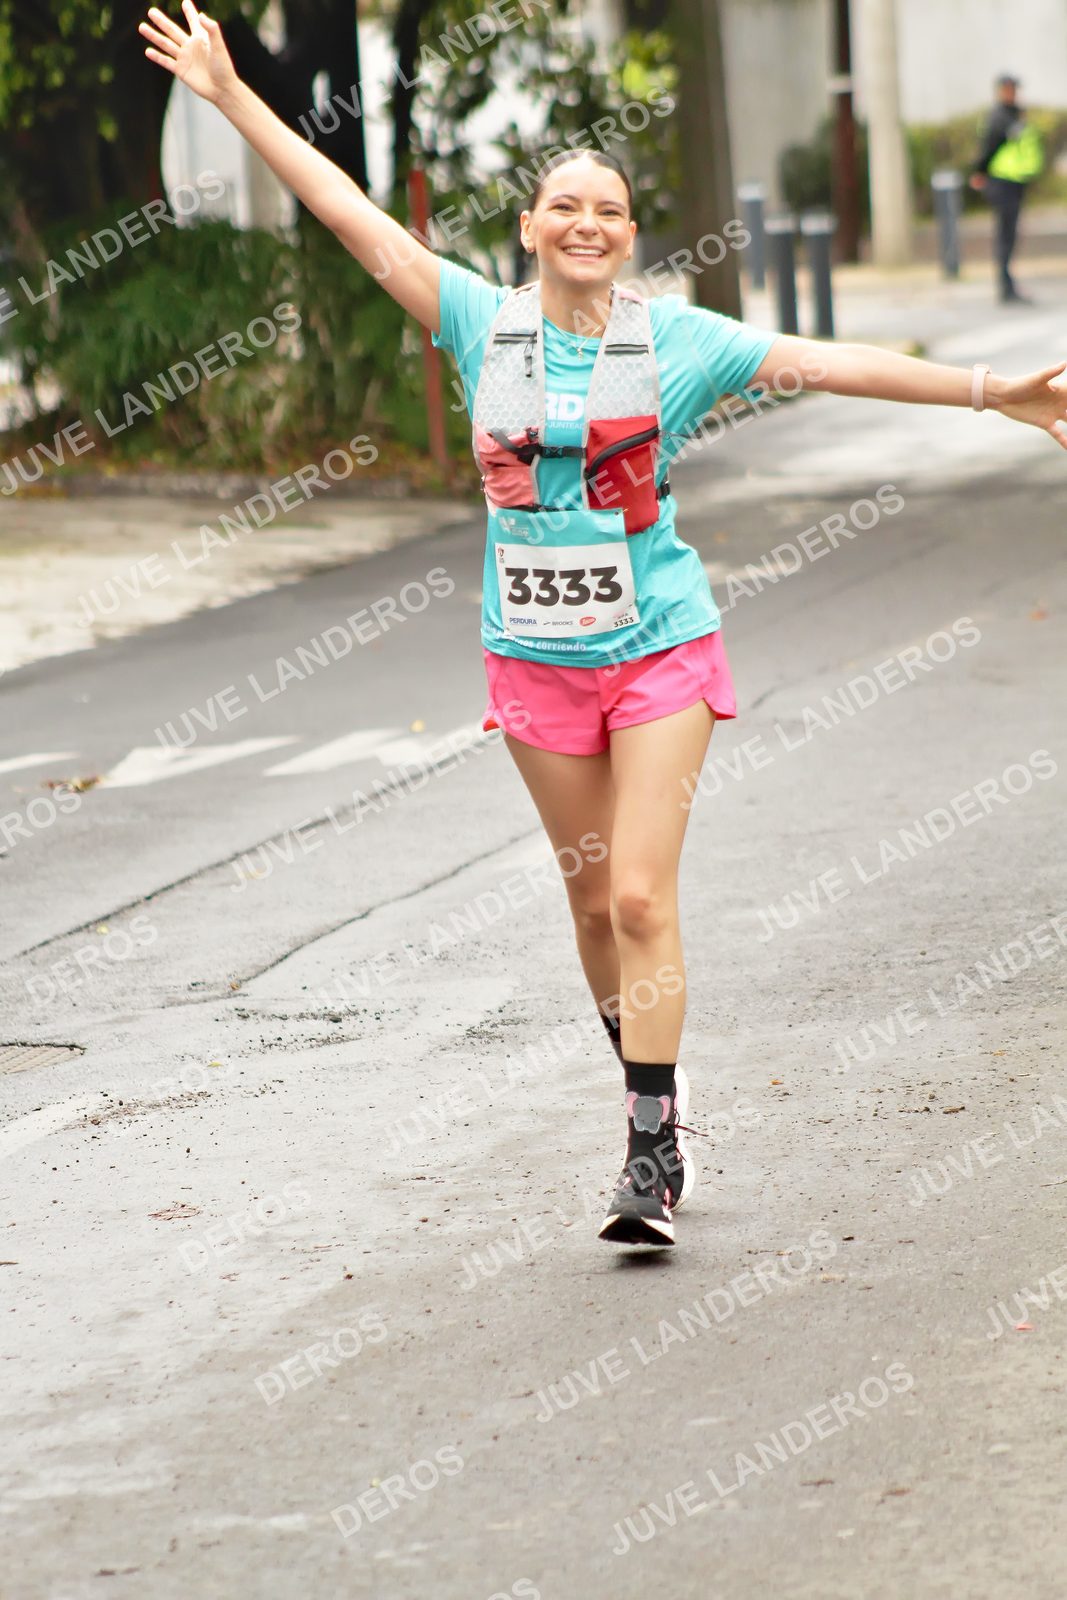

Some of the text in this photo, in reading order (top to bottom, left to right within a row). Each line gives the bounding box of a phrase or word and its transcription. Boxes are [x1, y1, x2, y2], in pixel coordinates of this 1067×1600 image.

[505, 565, 623, 607] 3333
[509, 617, 537, 625] PERDURA
[613, 616, 634, 628] 3333
[536, 640, 587, 652] corriendo
